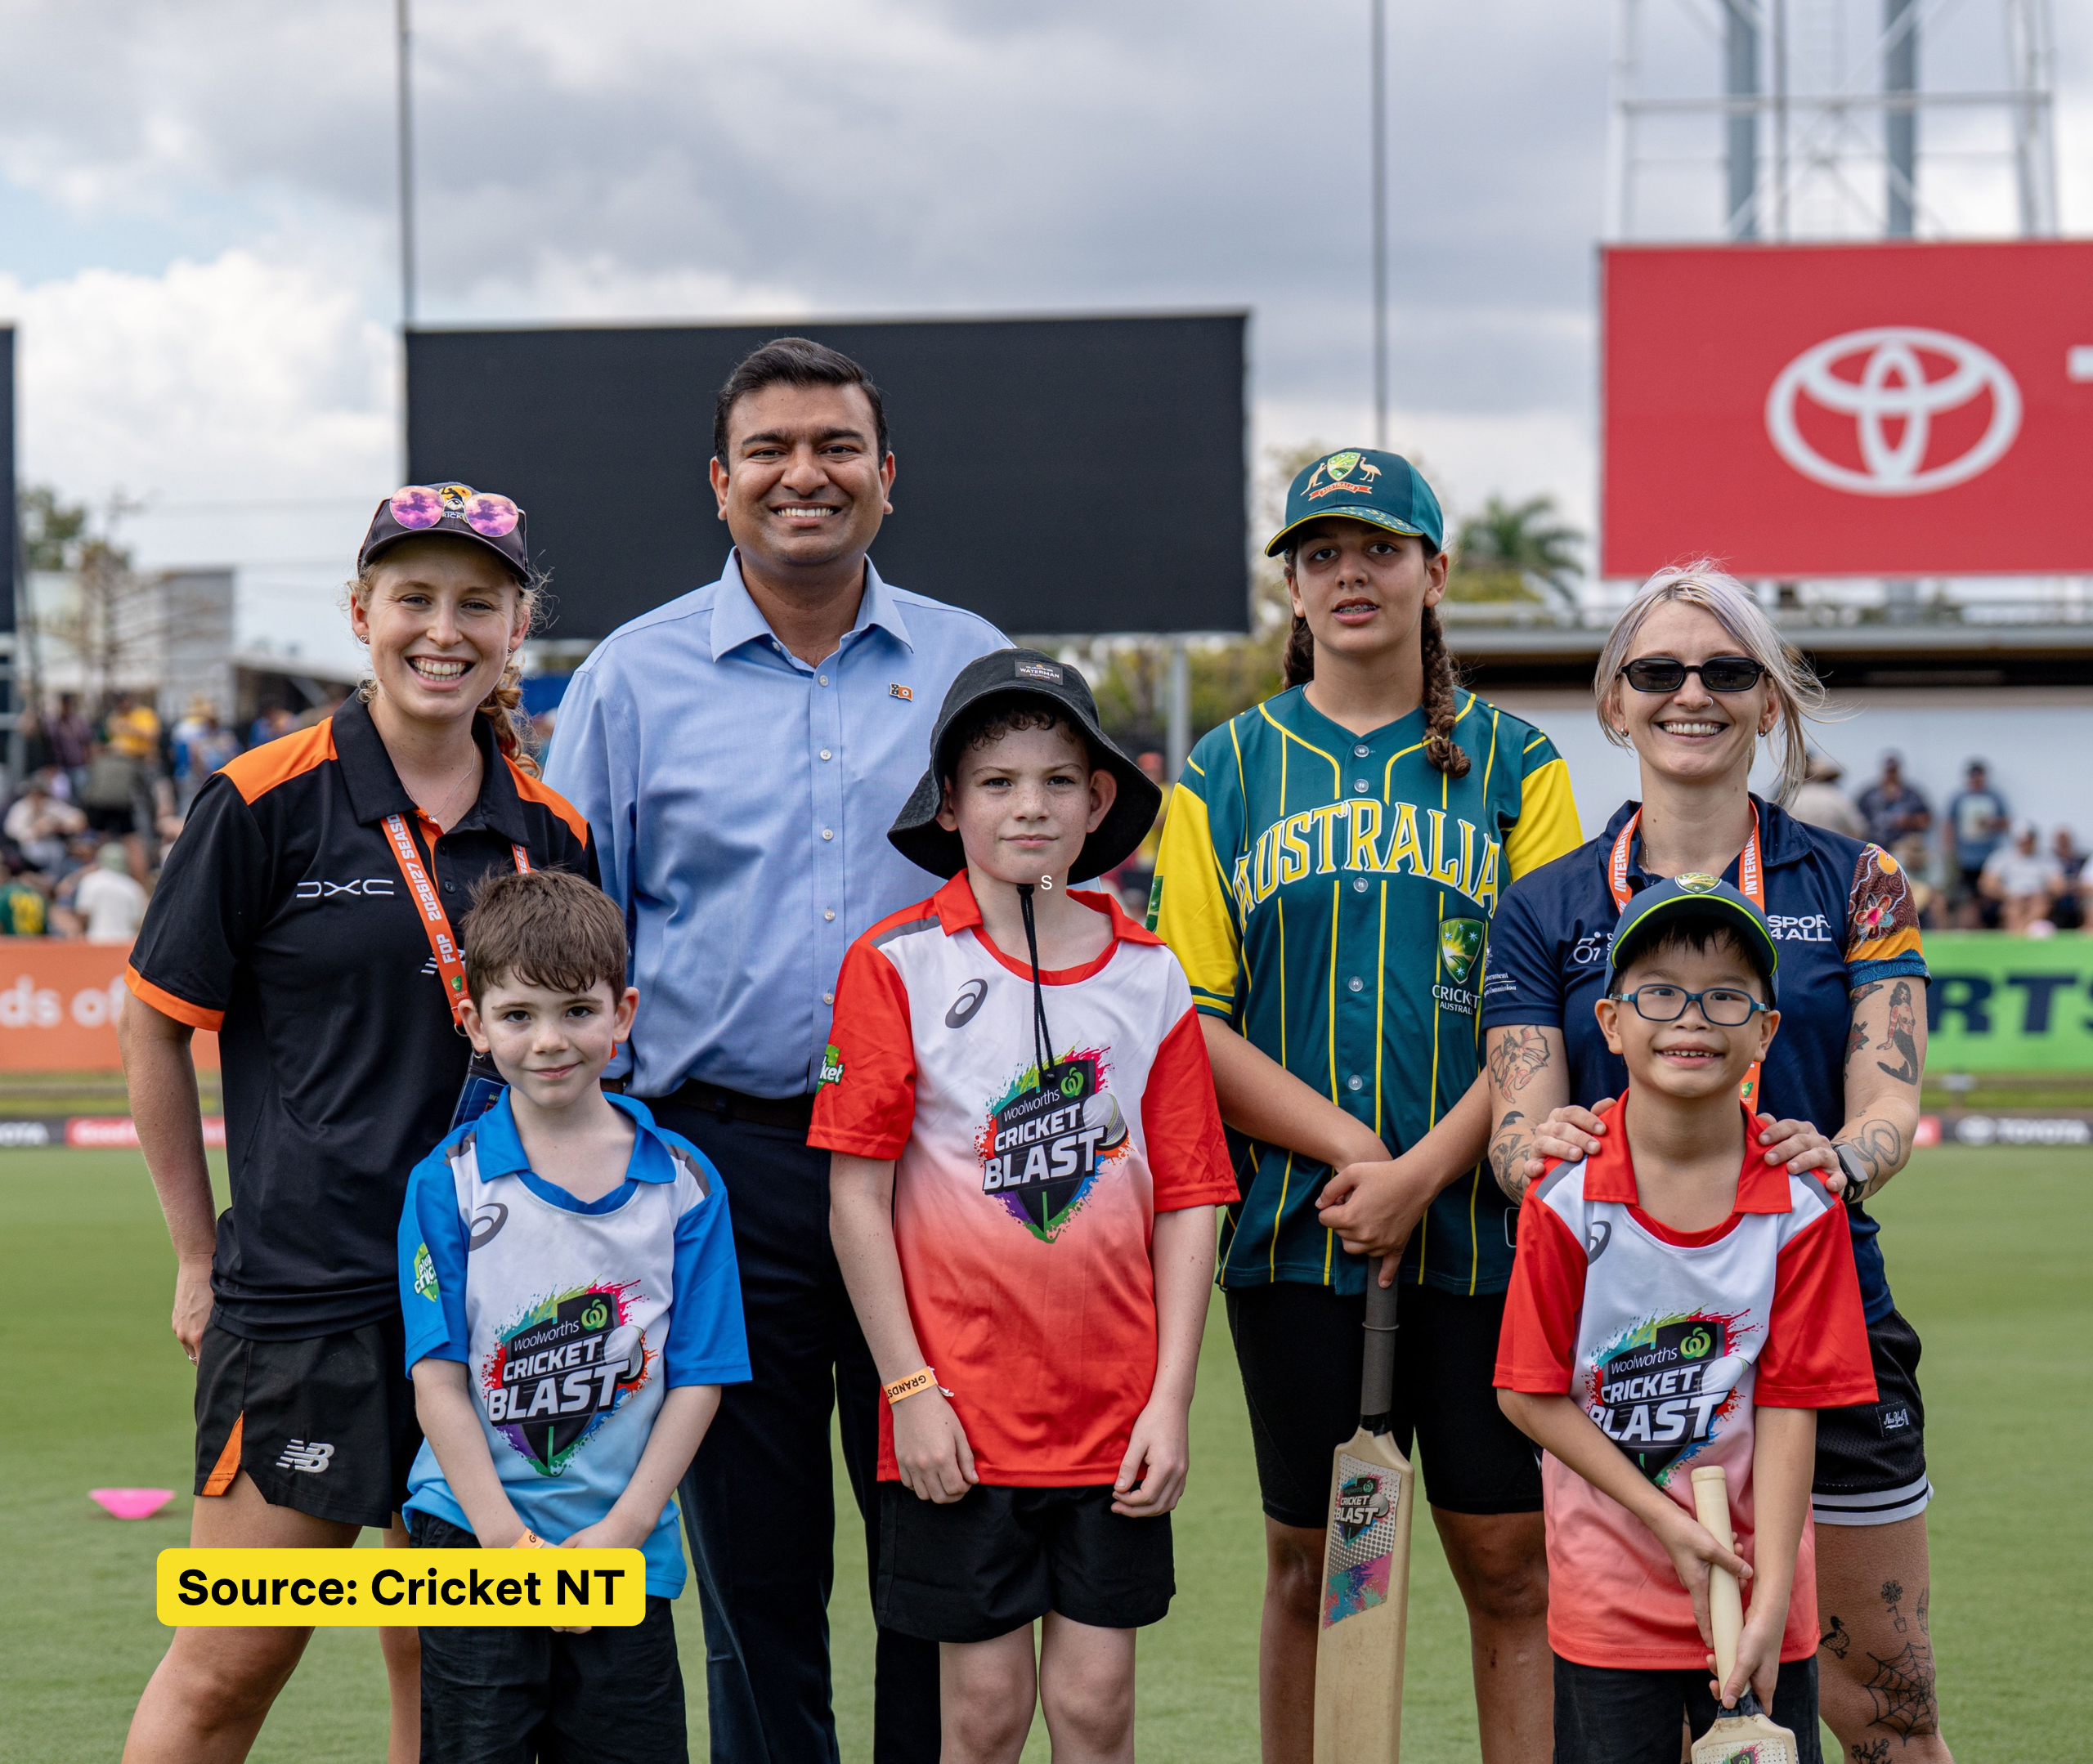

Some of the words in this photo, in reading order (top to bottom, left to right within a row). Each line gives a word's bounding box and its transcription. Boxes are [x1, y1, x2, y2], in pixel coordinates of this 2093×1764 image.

[1321, 482, 1356, 495] AUSTRALIA
[1020, 667, 1060, 678] WATERMAN
[1233, 798, 1500, 934] AUSTRALIA
[296, 879, 394, 898] DXC
[406, 862, 442, 922] 2026/27
[436, 933, 456, 964] FOP
[1432, 984, 1481, 1009] CRICKT
[1927, 974, 2093, 1033] RT
[994, 1102, 1081, 1152] CRICKET
[982, 1126, 1105, 1190] BLAST
[502, 1335, 603, 1382] CRICKET
[488, 1359, 630, 1422] BLAST
[1600, 1364, 1702, 1404] CRICKET
[1336, 1507, 1379, 1525] BLAST
[1341, 1495, 1370, 1506] CRICKET
